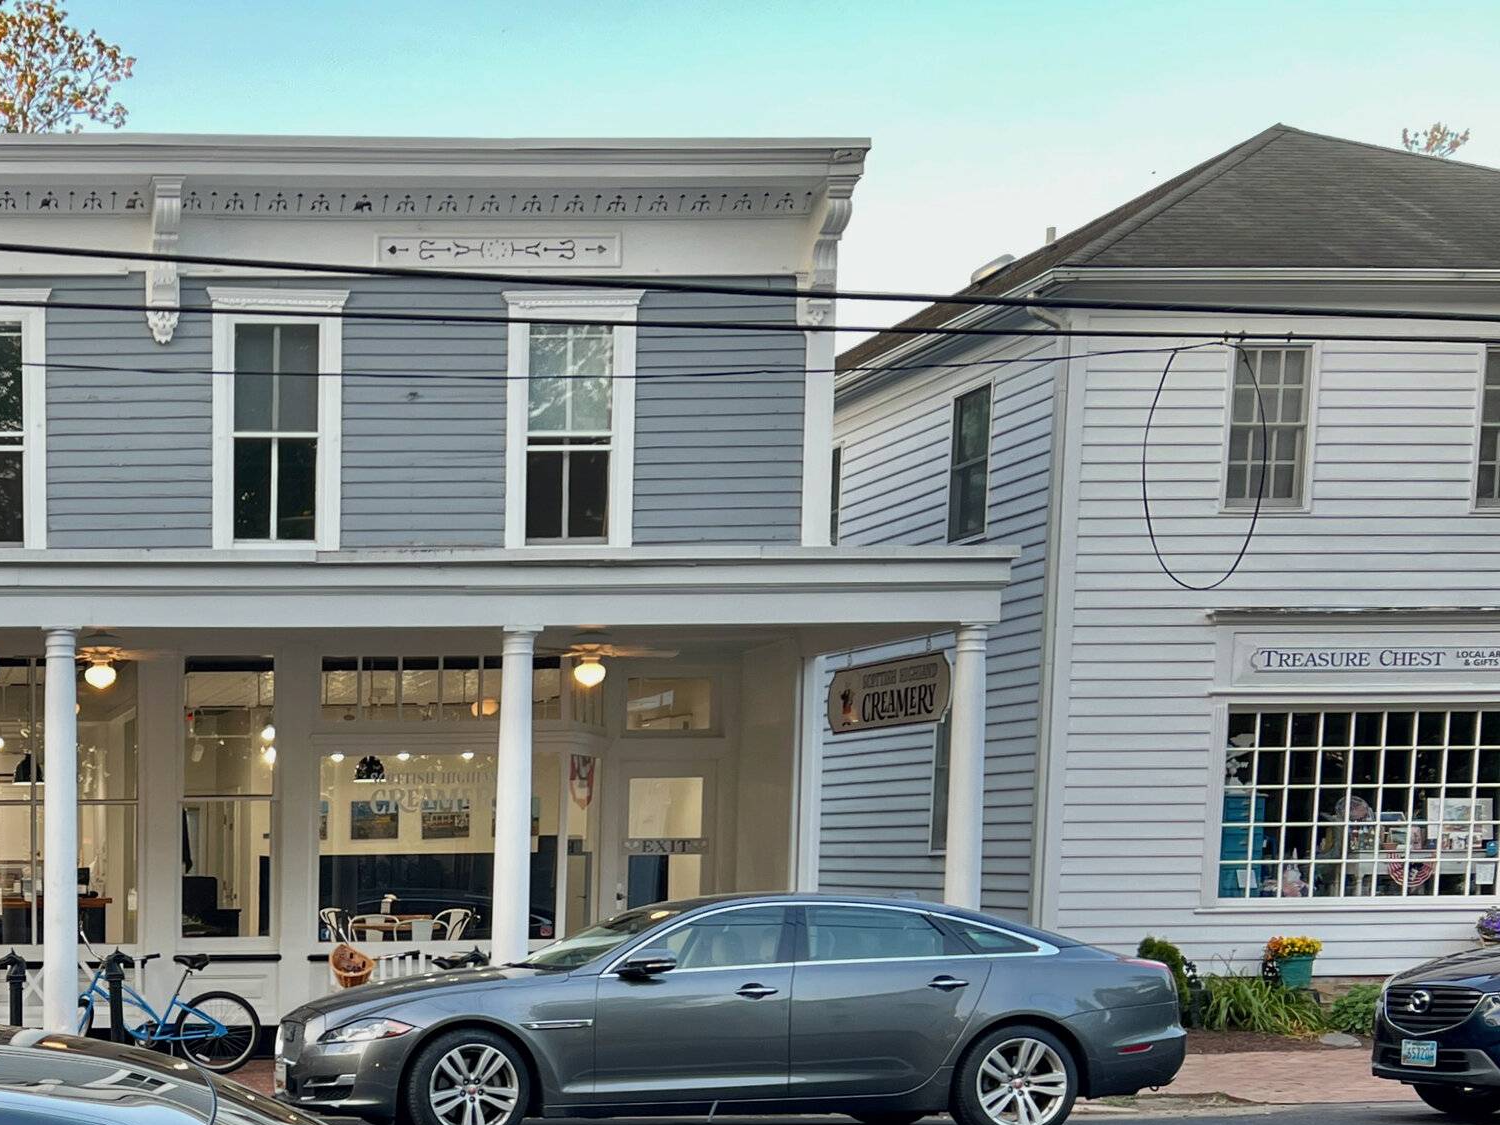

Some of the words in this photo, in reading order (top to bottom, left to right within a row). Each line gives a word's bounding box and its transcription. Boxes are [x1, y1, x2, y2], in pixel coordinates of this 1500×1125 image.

[1260, 650, 1371, 667] TREASURE
[1380, 649, 1446, 667] CHEST
[1456, 651, 1486, 659] LOCAL
[1473, 659, 1499, 667] GIFTS
[862, 684, 937, 722] CREAMERY
[370, 788, 494, 815] CREAMER
[642, 840, 692, 852] EXIT
